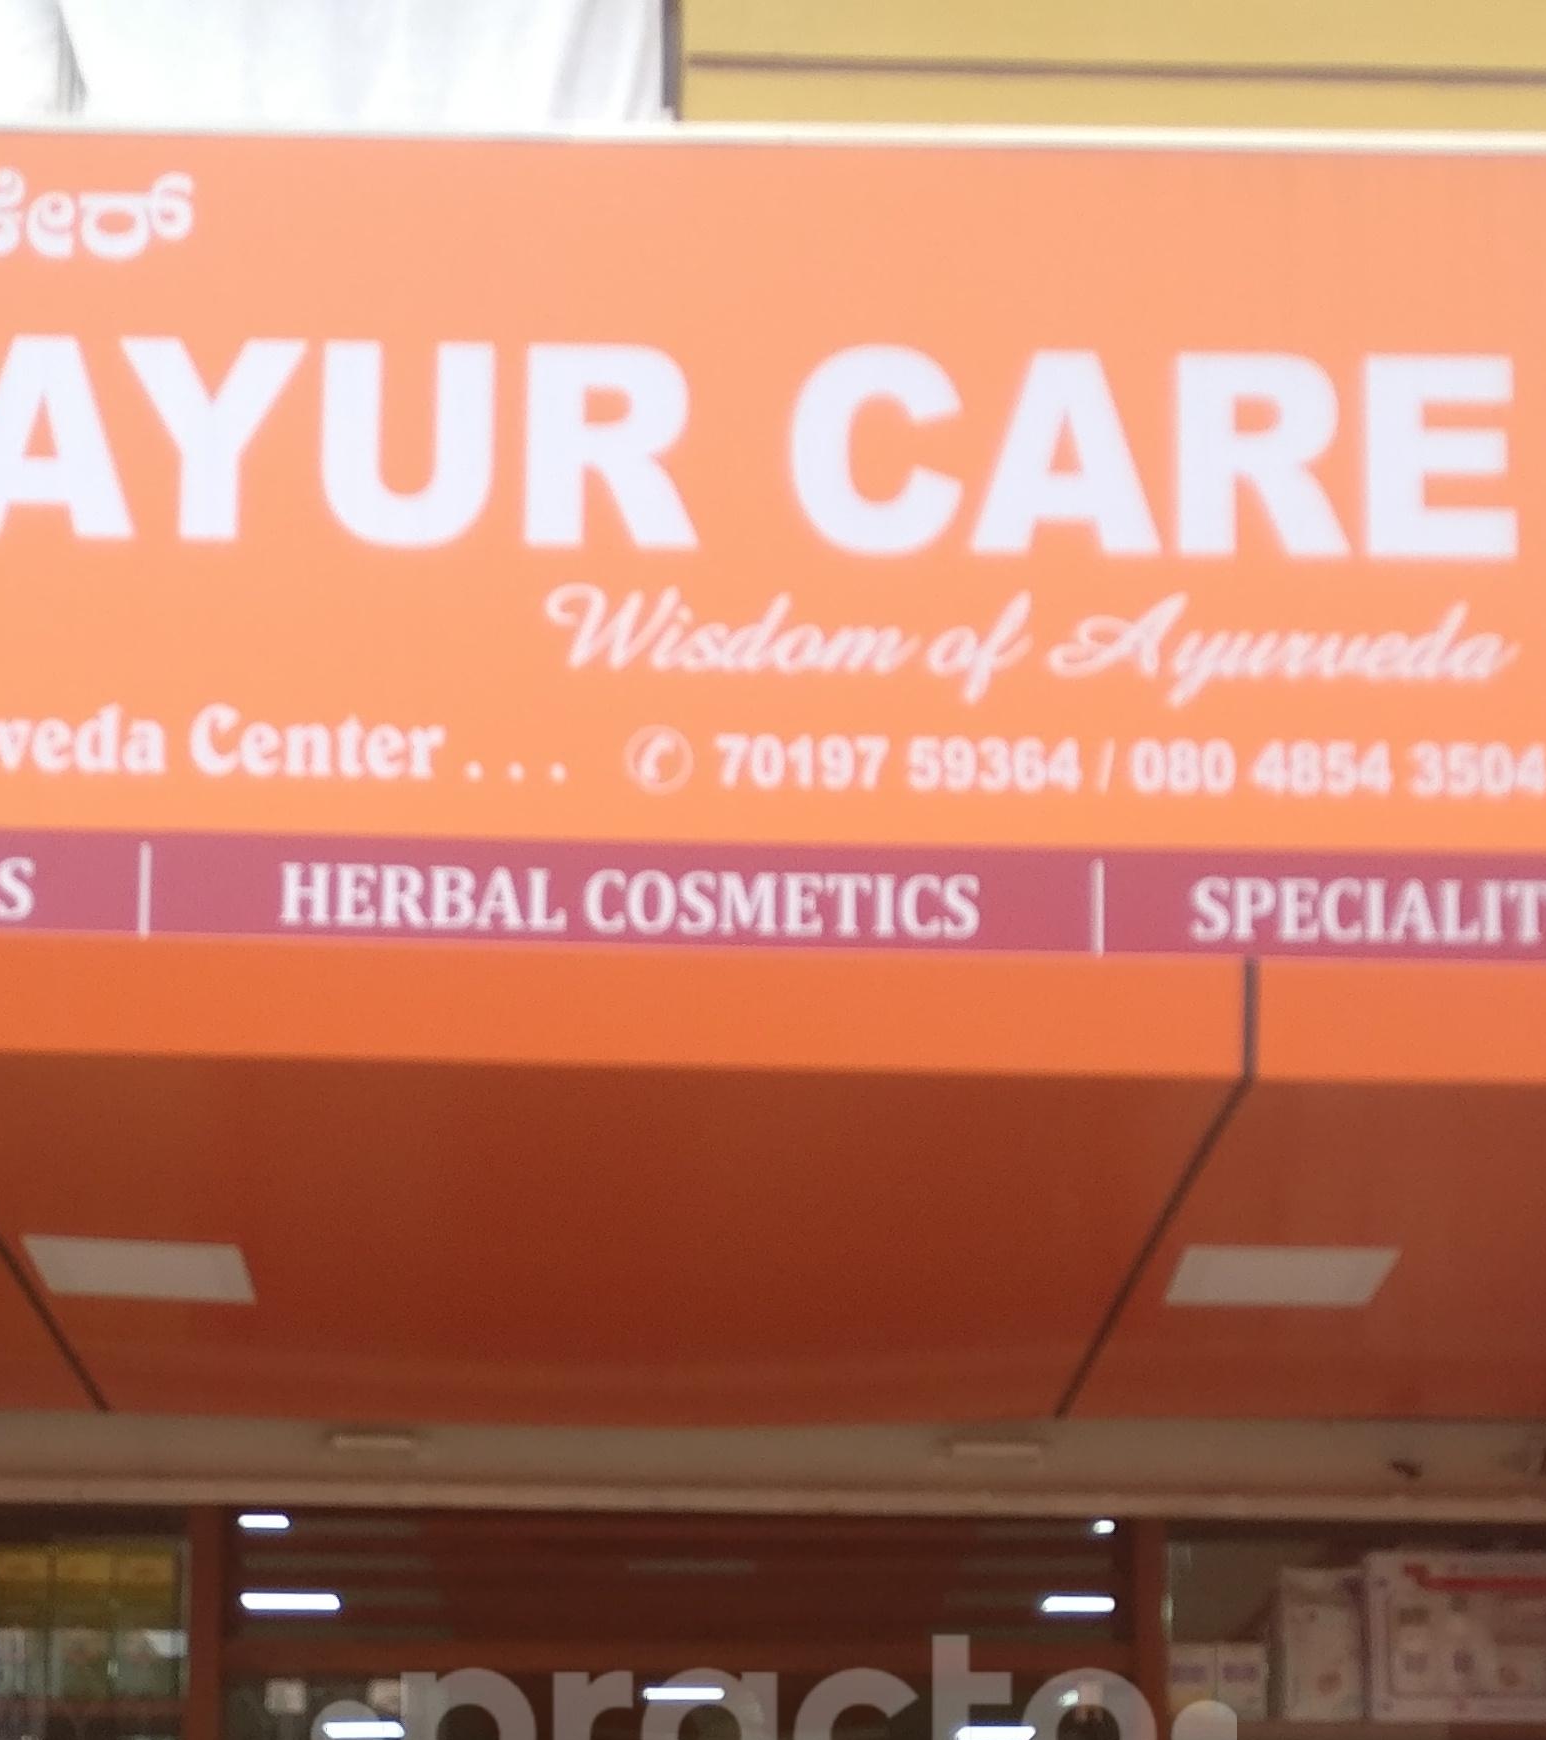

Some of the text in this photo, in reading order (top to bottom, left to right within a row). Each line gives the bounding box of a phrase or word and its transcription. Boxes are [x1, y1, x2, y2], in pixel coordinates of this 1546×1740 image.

[789, 345, 1518, 560] CARE
[544, 584, 1515, 707] Wisdom of Ayurveda
[190, 704, 445, 779] Center
[715, 734, 889, 789] 70197
[907, 737, 1082, 792] 59364
[1129, 740, 1236, 793] 080
[1250, 741, 1392, 795] 4854
[281, 863, 978, 937] HERBAL COSMETICS
